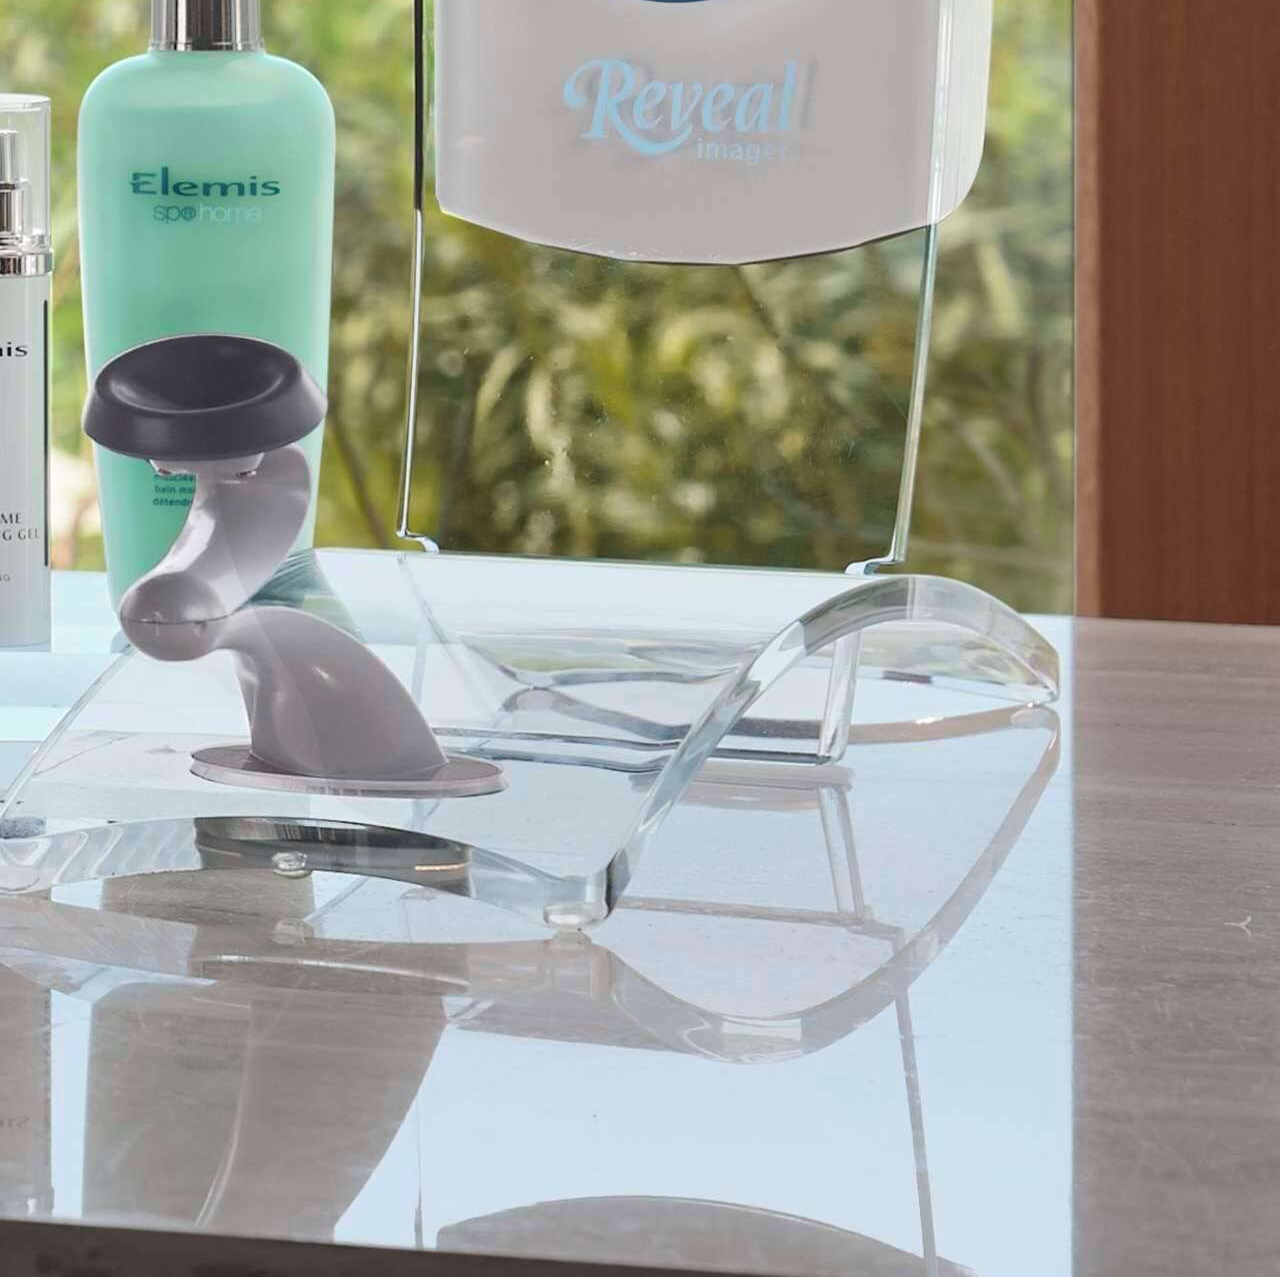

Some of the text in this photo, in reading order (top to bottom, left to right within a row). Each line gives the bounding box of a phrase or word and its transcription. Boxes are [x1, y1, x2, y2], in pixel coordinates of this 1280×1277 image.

[563, 58, 799, 154] Reveal
[130, 167, 281, 197] Elemis
[17, 528, 40, 540] GEL
